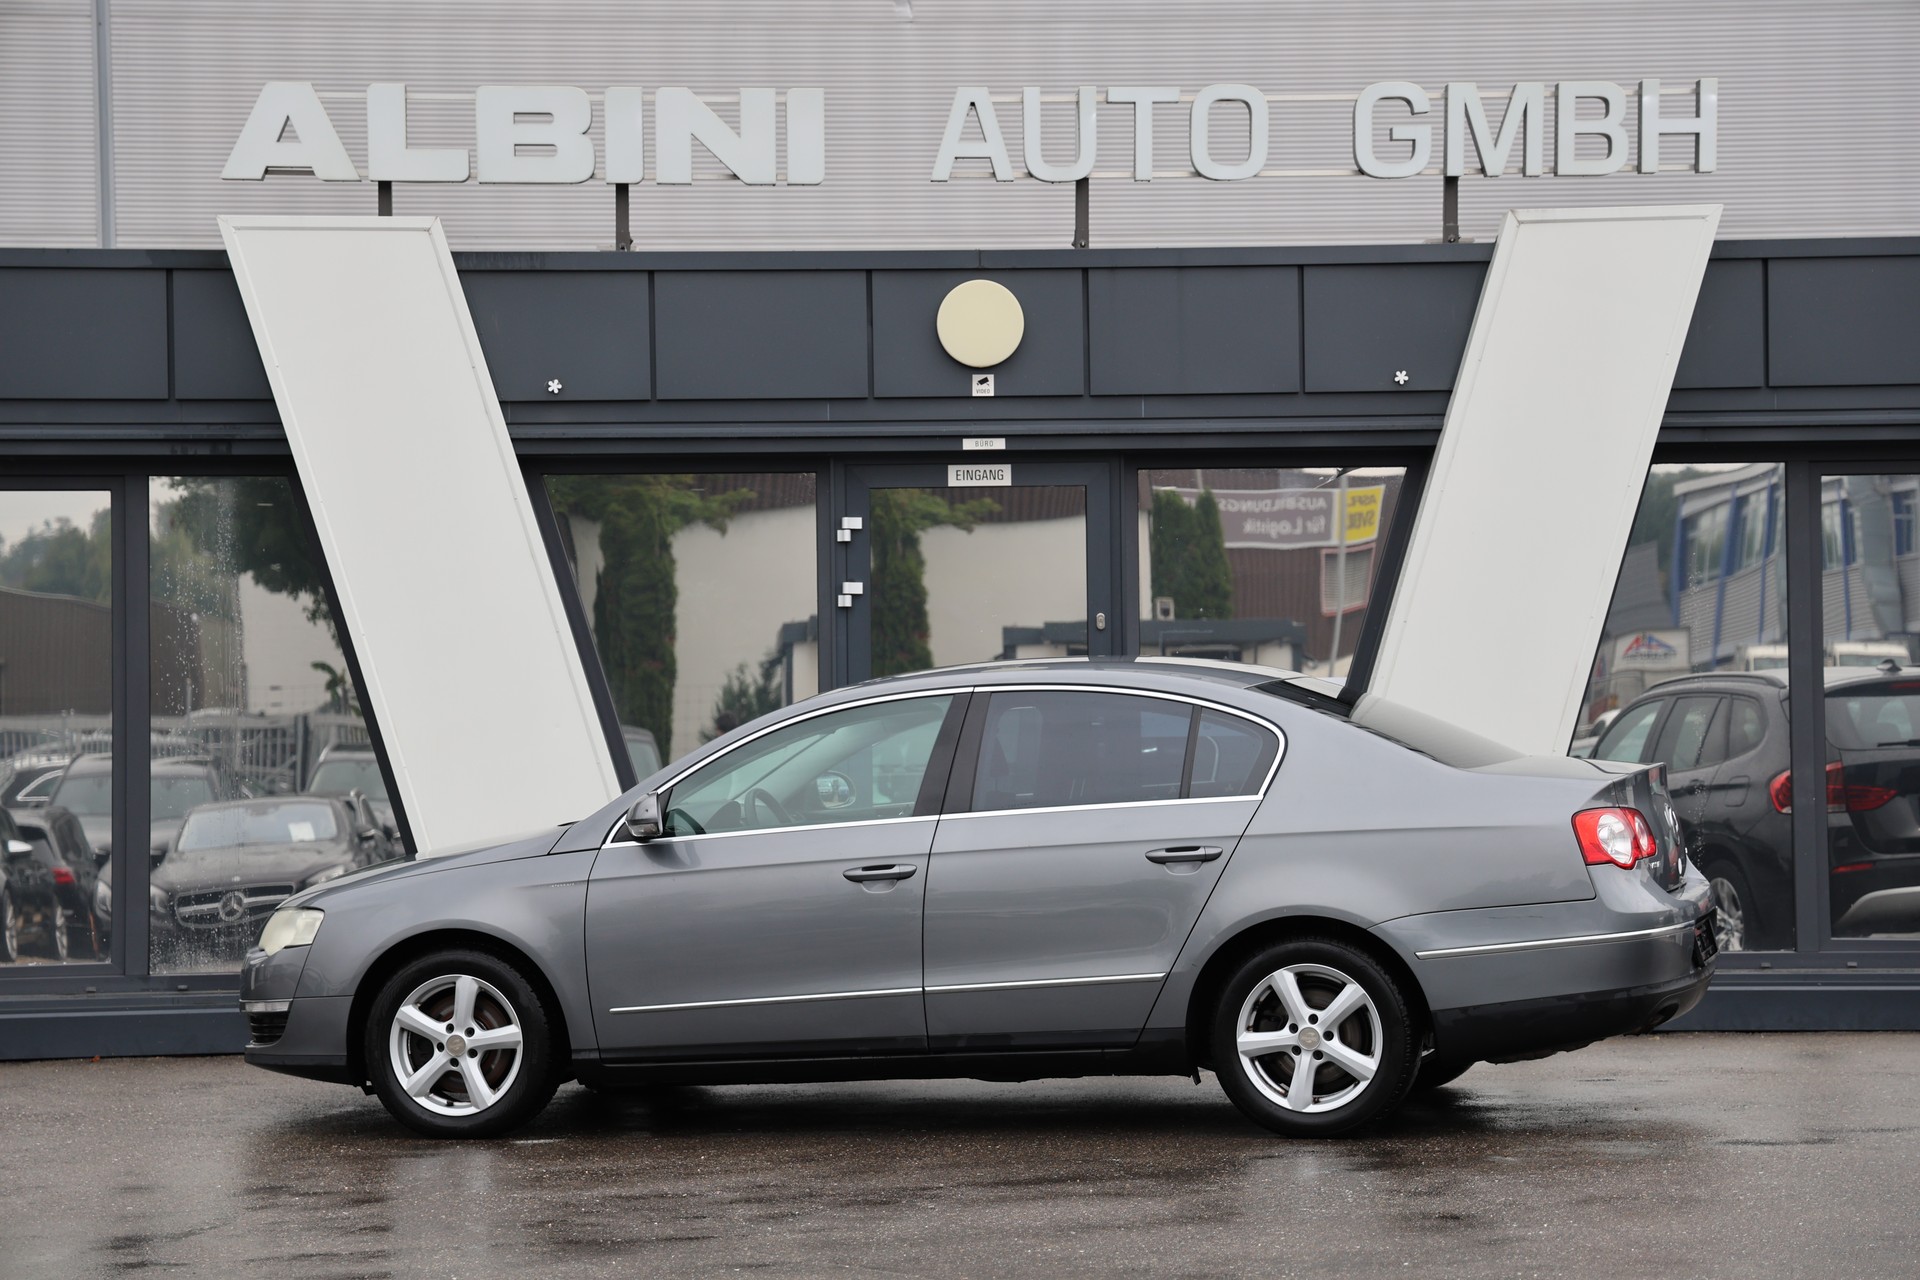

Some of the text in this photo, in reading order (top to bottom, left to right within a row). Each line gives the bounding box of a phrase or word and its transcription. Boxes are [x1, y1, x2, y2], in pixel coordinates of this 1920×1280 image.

[221, 77, 1719, 186] ALBINI AUTO GMBH
[974, 440, 994, 448] BÜRO
[955, 469, 1004, 481] EINGANG
